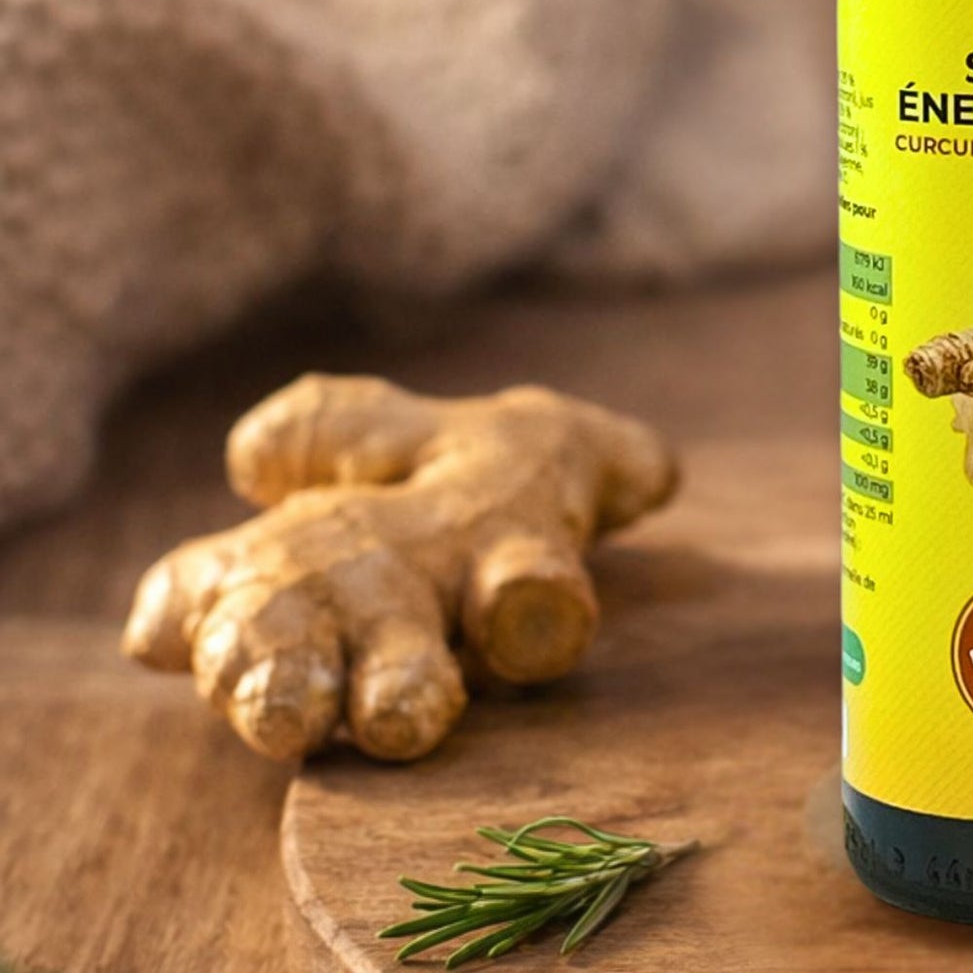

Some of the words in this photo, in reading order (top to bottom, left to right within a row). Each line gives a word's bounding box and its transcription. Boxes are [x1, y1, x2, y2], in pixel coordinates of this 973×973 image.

[866, 278, 888, 297] kcal
[870, 306, 878, 320] 0
[880, 310, 887, 325] g
[880, 335, 887, 350] g
[880, 359, 888, 375] g
[880, 385, 888, 400] g
[880, 410, 888, 424] g
[880, 434, 888, 451] g
[881, 460, 888, 475] g
[870, 481, 889, 500] mg
[879, 511, 893, 526] ml
